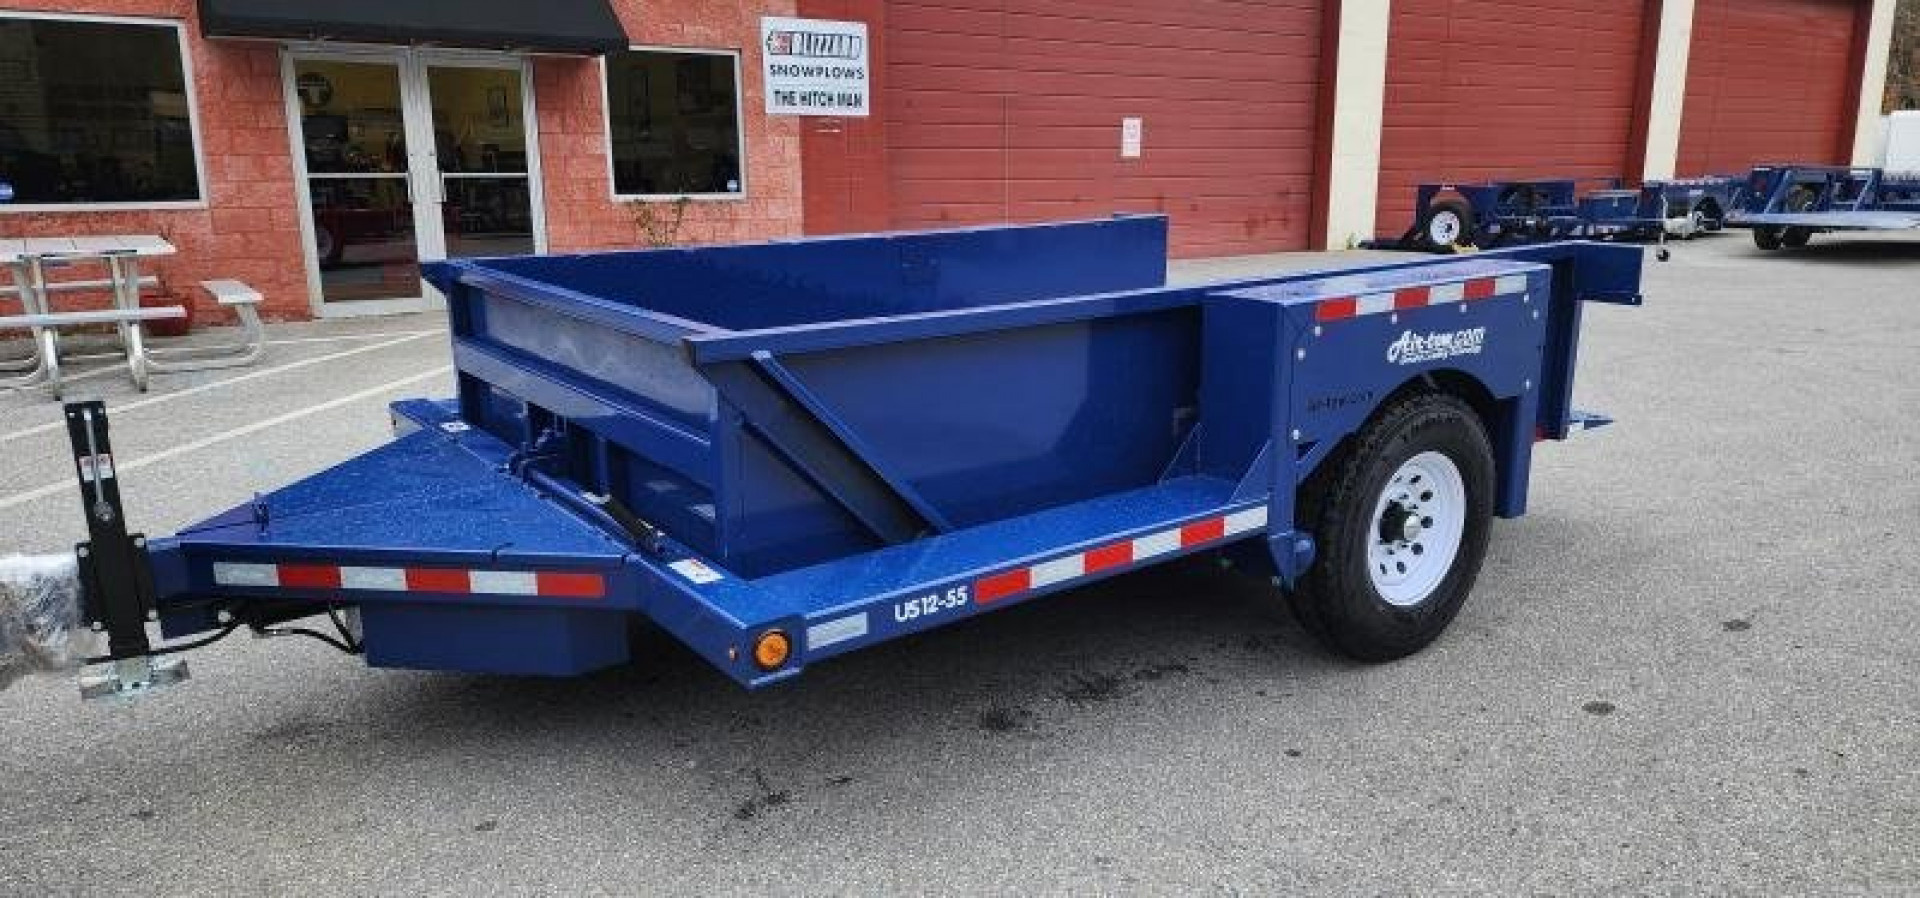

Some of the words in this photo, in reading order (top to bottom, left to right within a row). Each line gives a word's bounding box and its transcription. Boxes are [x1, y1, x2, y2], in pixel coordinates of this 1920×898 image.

[770, 64, 864, 79] SNOWPLOWS
[774, 90, 797, 106] THE
[800, 90, 834, 107] HITCH
[837, 92, 862, 108] MAN
